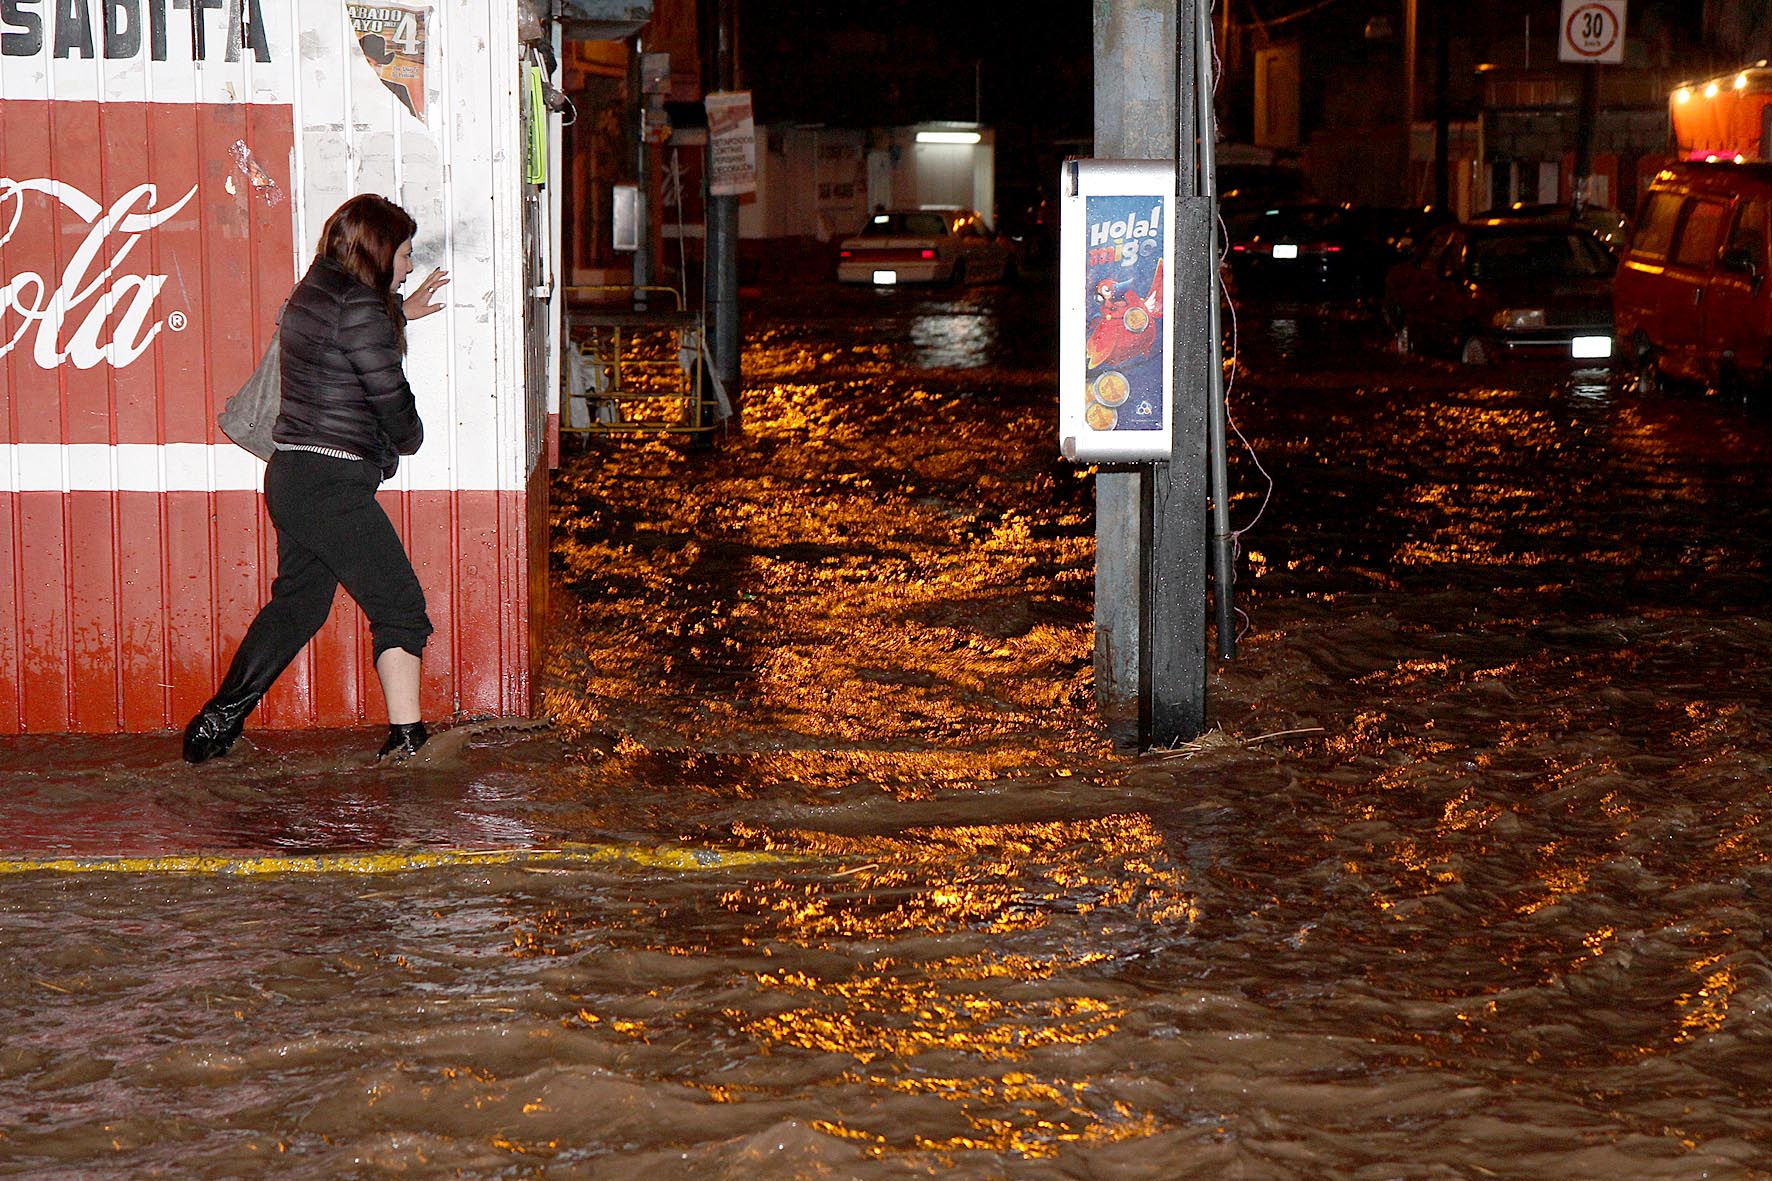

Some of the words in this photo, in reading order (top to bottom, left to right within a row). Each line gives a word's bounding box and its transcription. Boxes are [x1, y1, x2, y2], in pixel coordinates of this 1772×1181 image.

[1, 0, 271, 62] SADITA
[392, 12, 421, 54] 4
[1582, 12, 1603, 38] 30
[1091, 206, 1160, 246] Hola!
